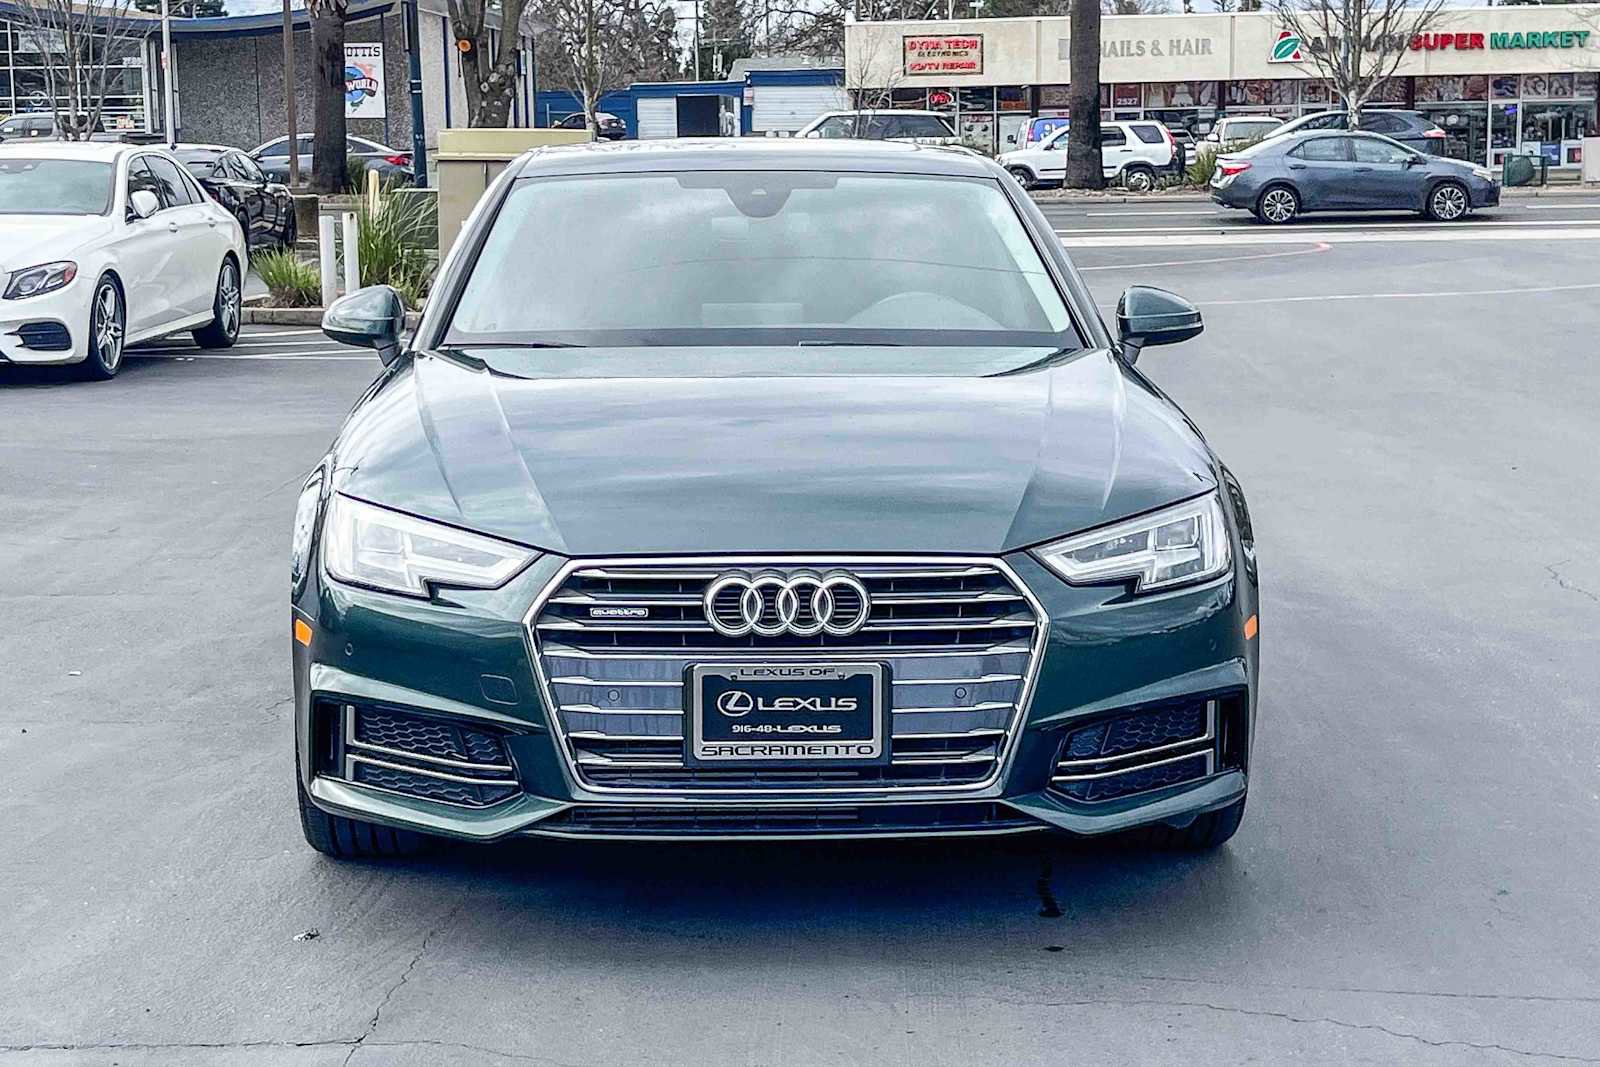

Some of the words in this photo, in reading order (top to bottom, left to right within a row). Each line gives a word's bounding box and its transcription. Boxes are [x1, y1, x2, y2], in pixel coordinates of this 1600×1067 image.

[944, 39, 977, 49] TECH
[1410, 33, 1485, 50] SUPER
[1490, 31, 1590, 49] MARKET
[345, 45, 380, 57] OTTI'S
[1151, 39, 1164, 56] &
[1169, 38, 1213, 55] HAIR
[592, 608, 646, 616] quattro
[740, 668, 804, 676] LEXUS
[809, 668, 835, 676] OF
[757, 697, 858, 711] LEXUS
[701, 744, 874, 756] SACRAMENTO
